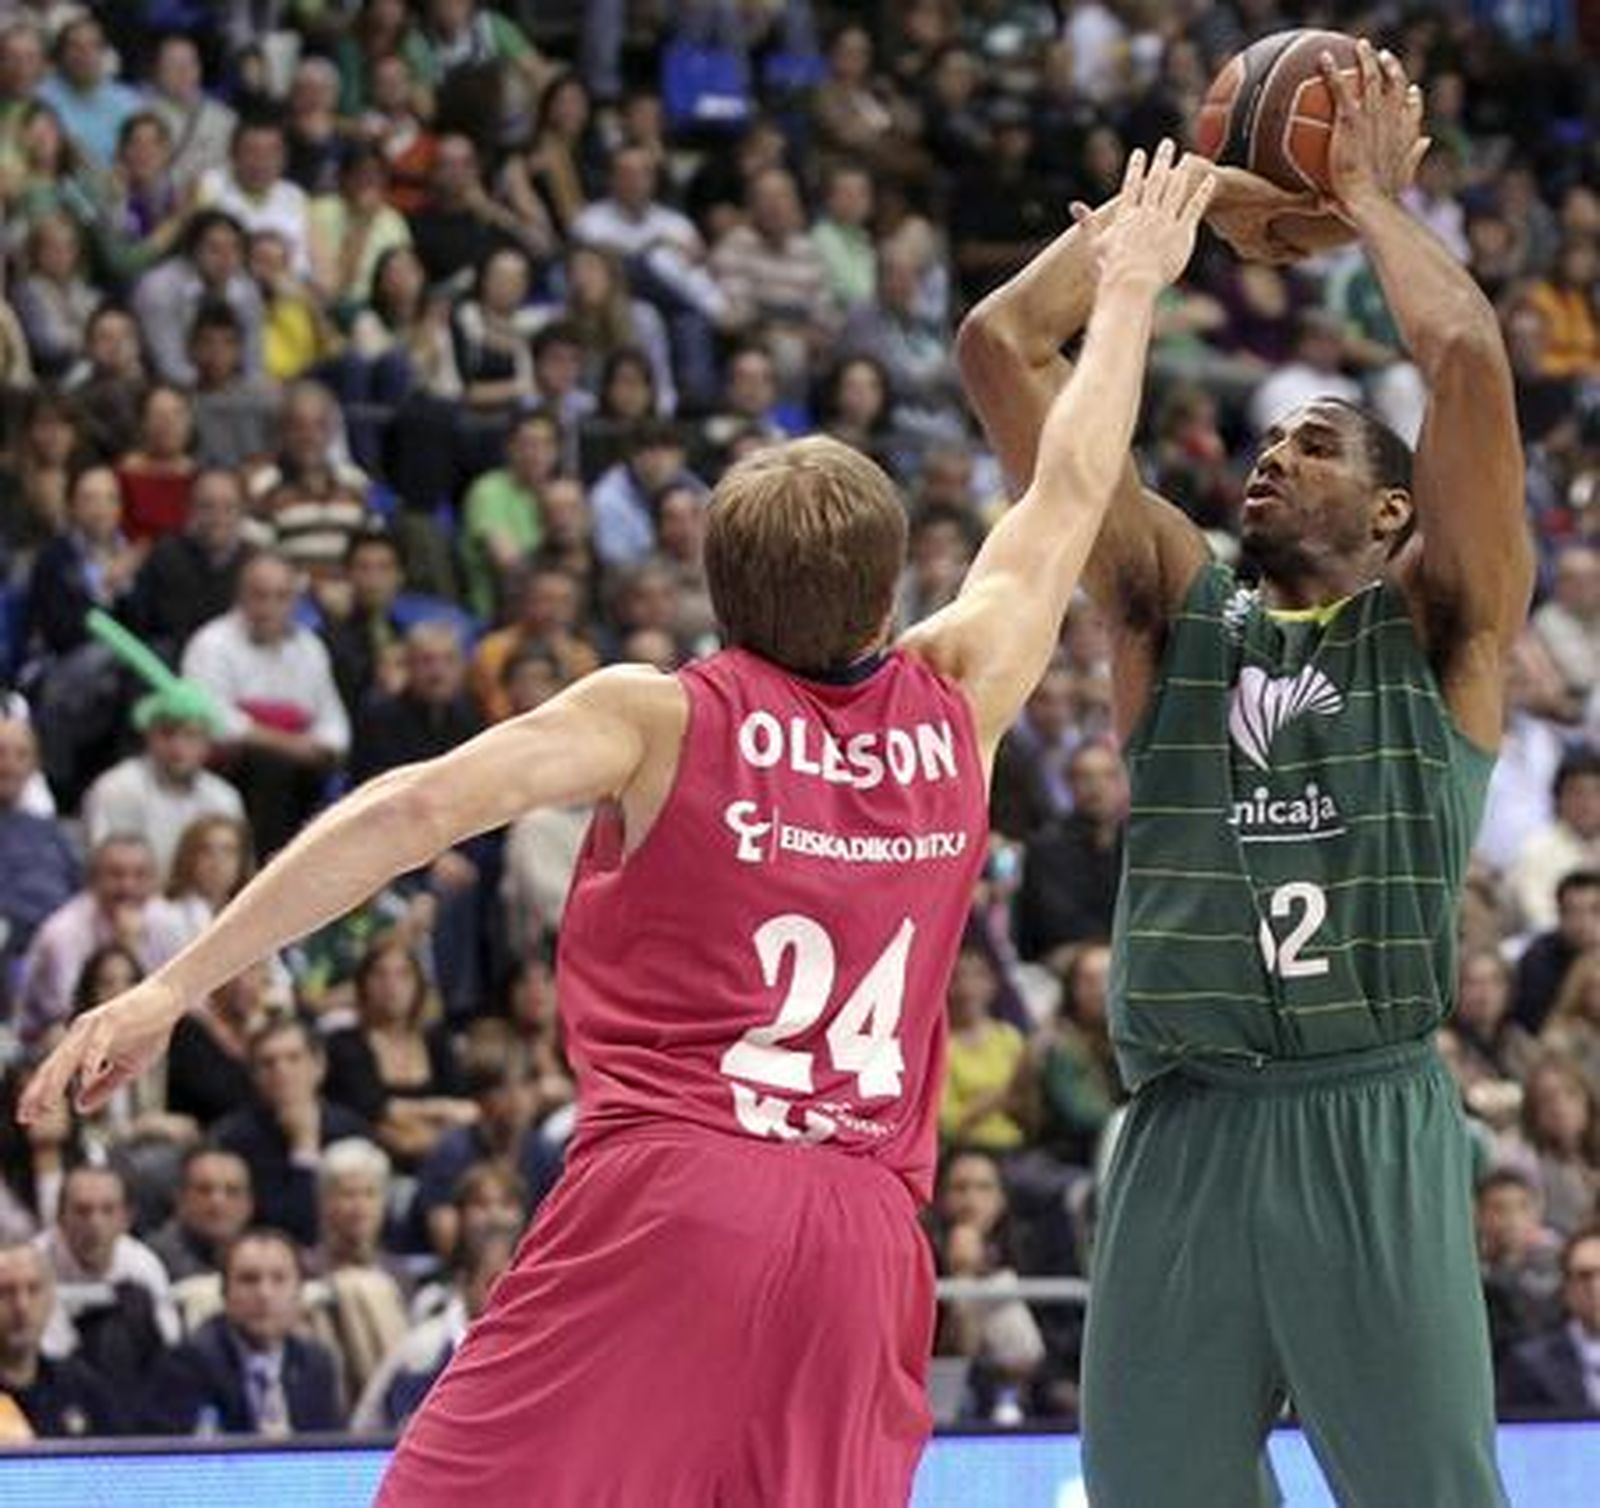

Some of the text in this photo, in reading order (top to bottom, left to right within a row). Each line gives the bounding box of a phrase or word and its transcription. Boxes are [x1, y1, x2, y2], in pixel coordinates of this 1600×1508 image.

[738, 710, 957, 789] OLESON
[1227, 783, 1338, 830] nicaja
[719, 913, 914, 1098] 24
